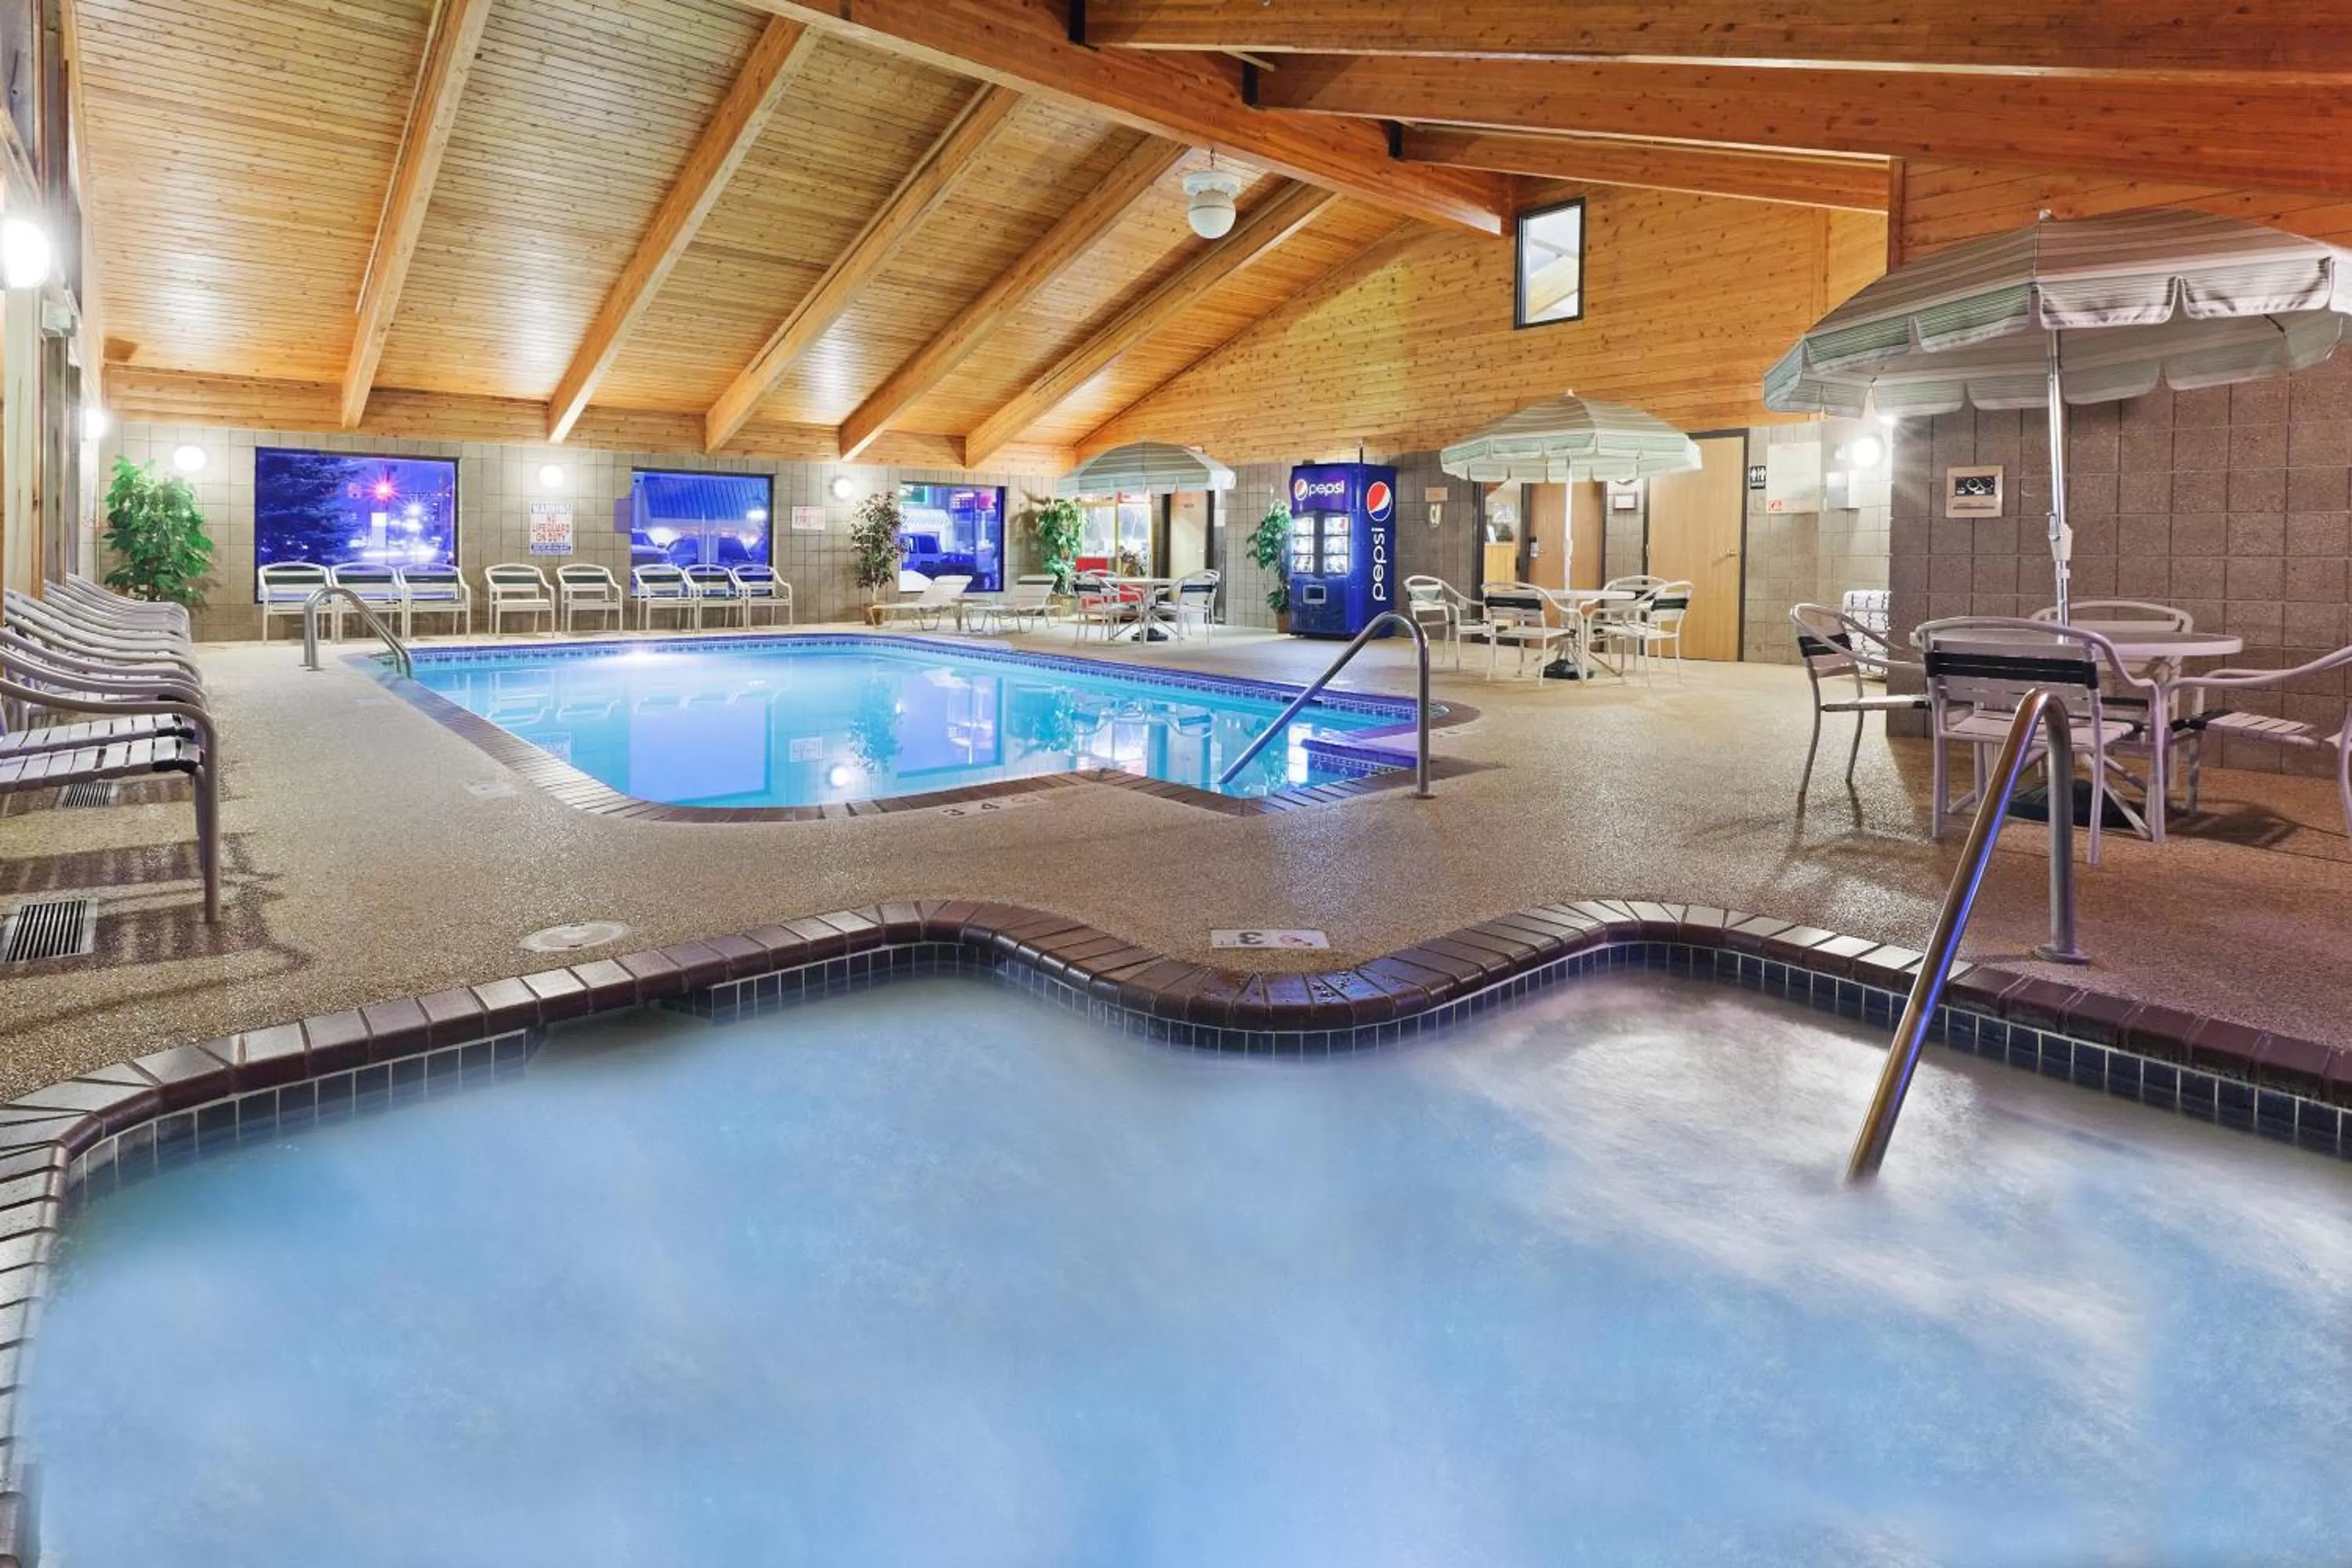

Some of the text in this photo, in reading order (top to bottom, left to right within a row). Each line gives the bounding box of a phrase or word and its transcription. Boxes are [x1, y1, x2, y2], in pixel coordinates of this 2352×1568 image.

[1308, 480, 1345, 497] pepsi
[1371, 528, 1387, 601] pepsi
[1239, 931, 1264, 945] 3
